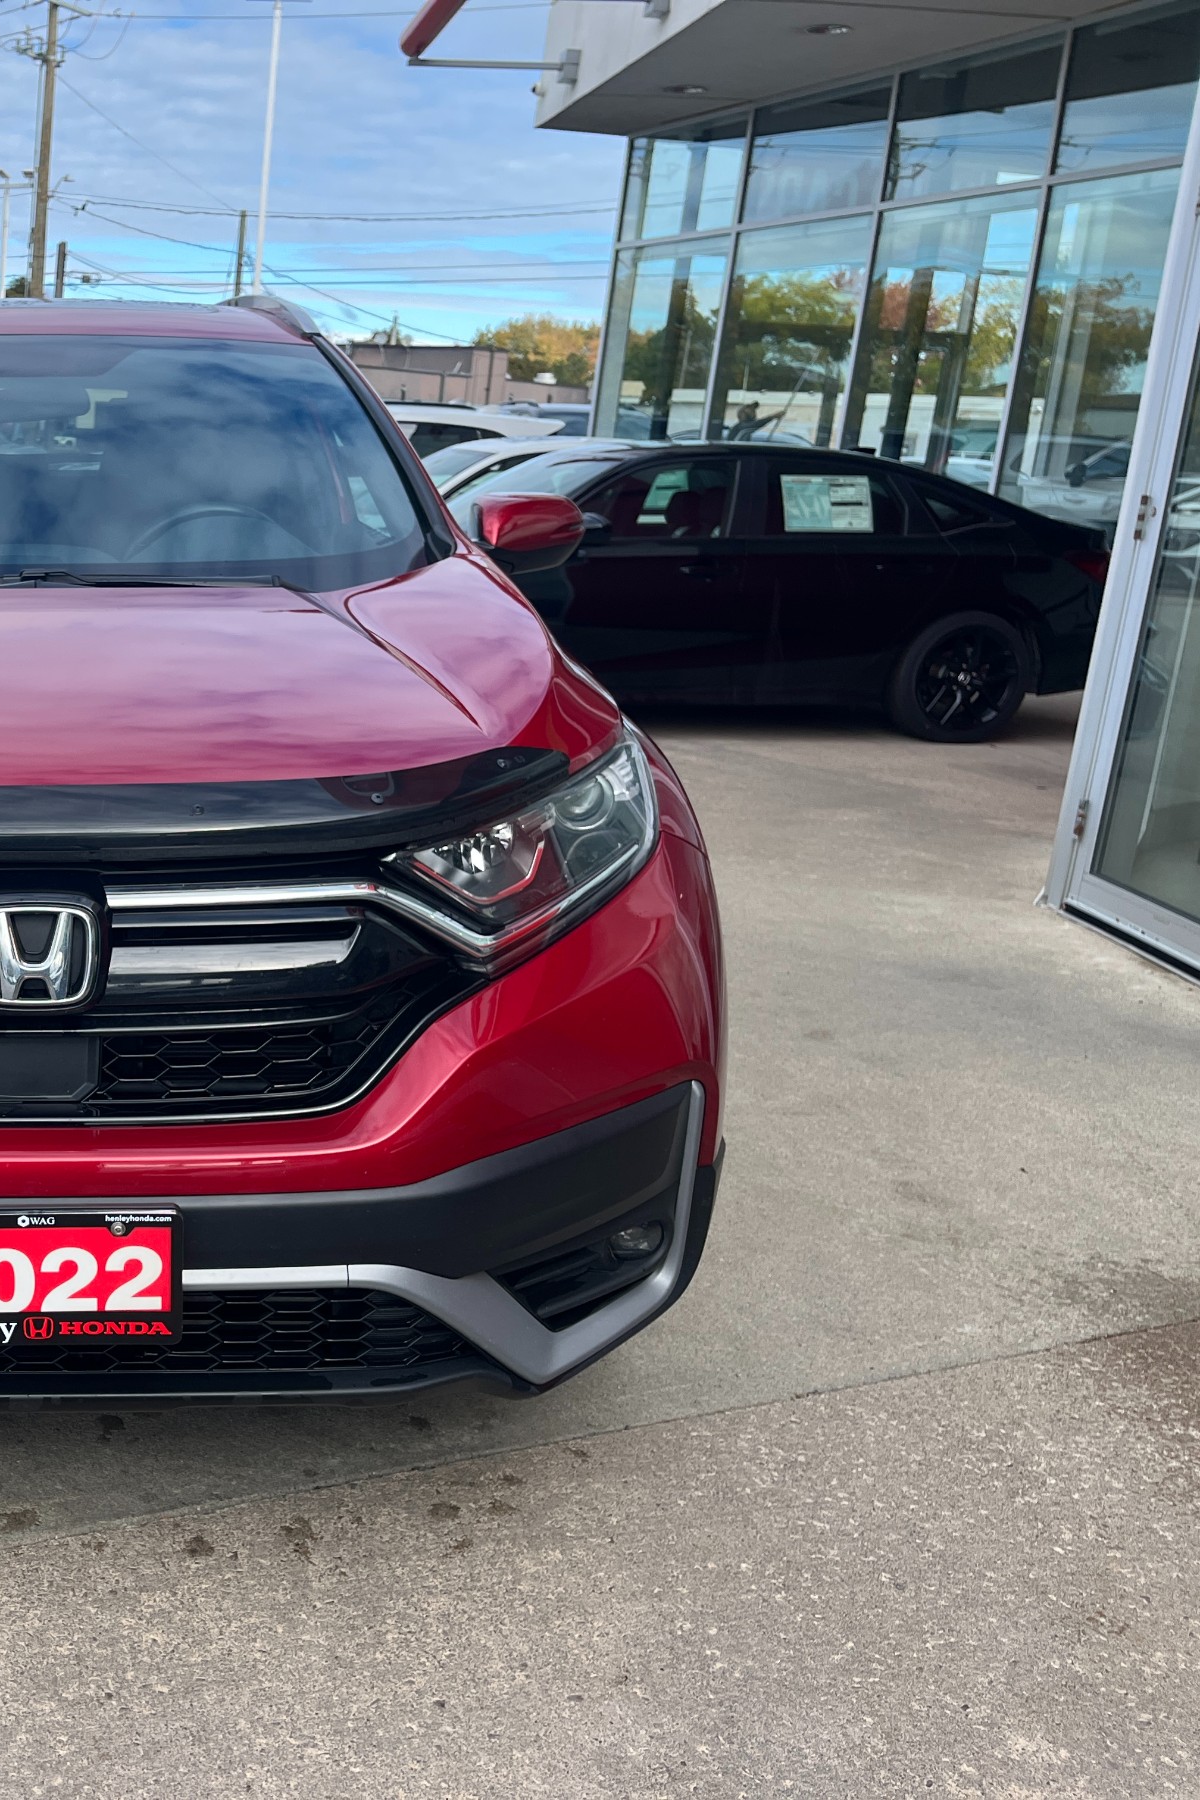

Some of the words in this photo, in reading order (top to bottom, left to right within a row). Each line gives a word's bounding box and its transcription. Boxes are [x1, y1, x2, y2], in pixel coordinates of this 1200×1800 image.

[30, 1216, 55, 1225] WAG
[105, 1214, 172, 1223] henleyhonda.com
[59, 1321, 172, 1335] HONDA
